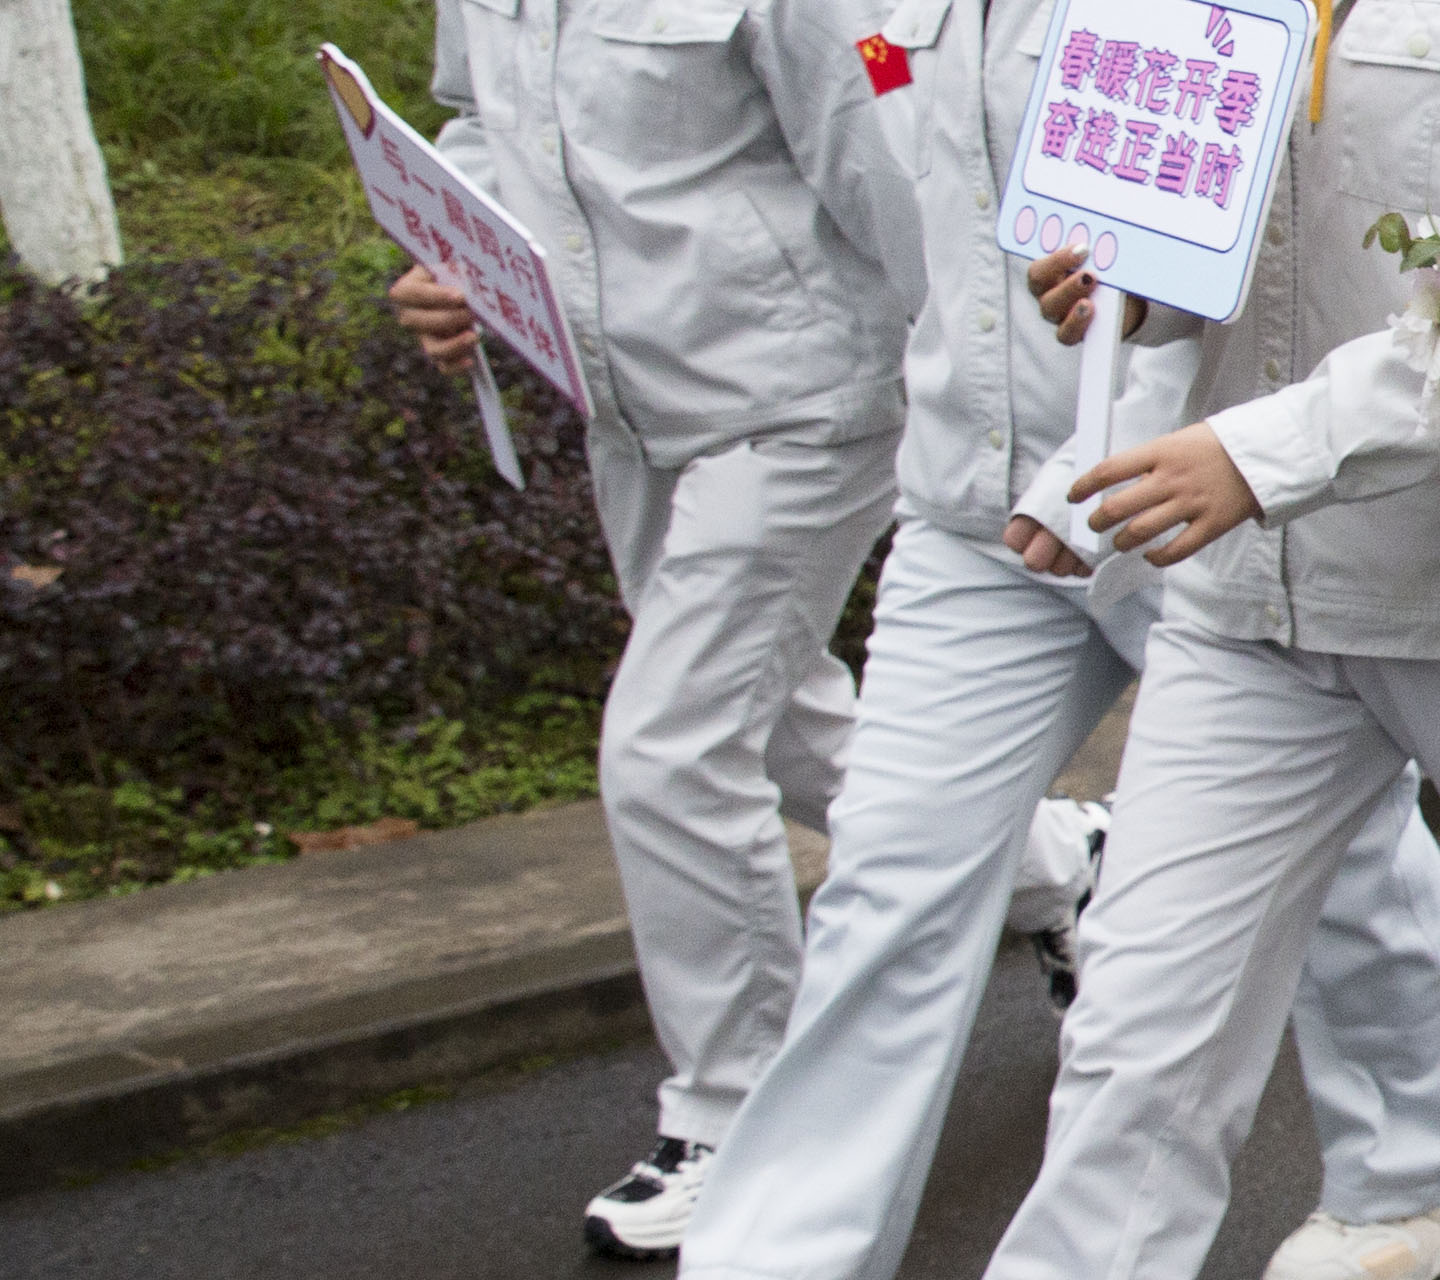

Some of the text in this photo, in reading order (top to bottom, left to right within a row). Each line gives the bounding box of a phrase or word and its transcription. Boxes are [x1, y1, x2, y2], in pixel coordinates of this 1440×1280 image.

[1060, 28, 1262, 136] 春暖花开季
[1041, 98, 1243, 210] 奋进正当时
